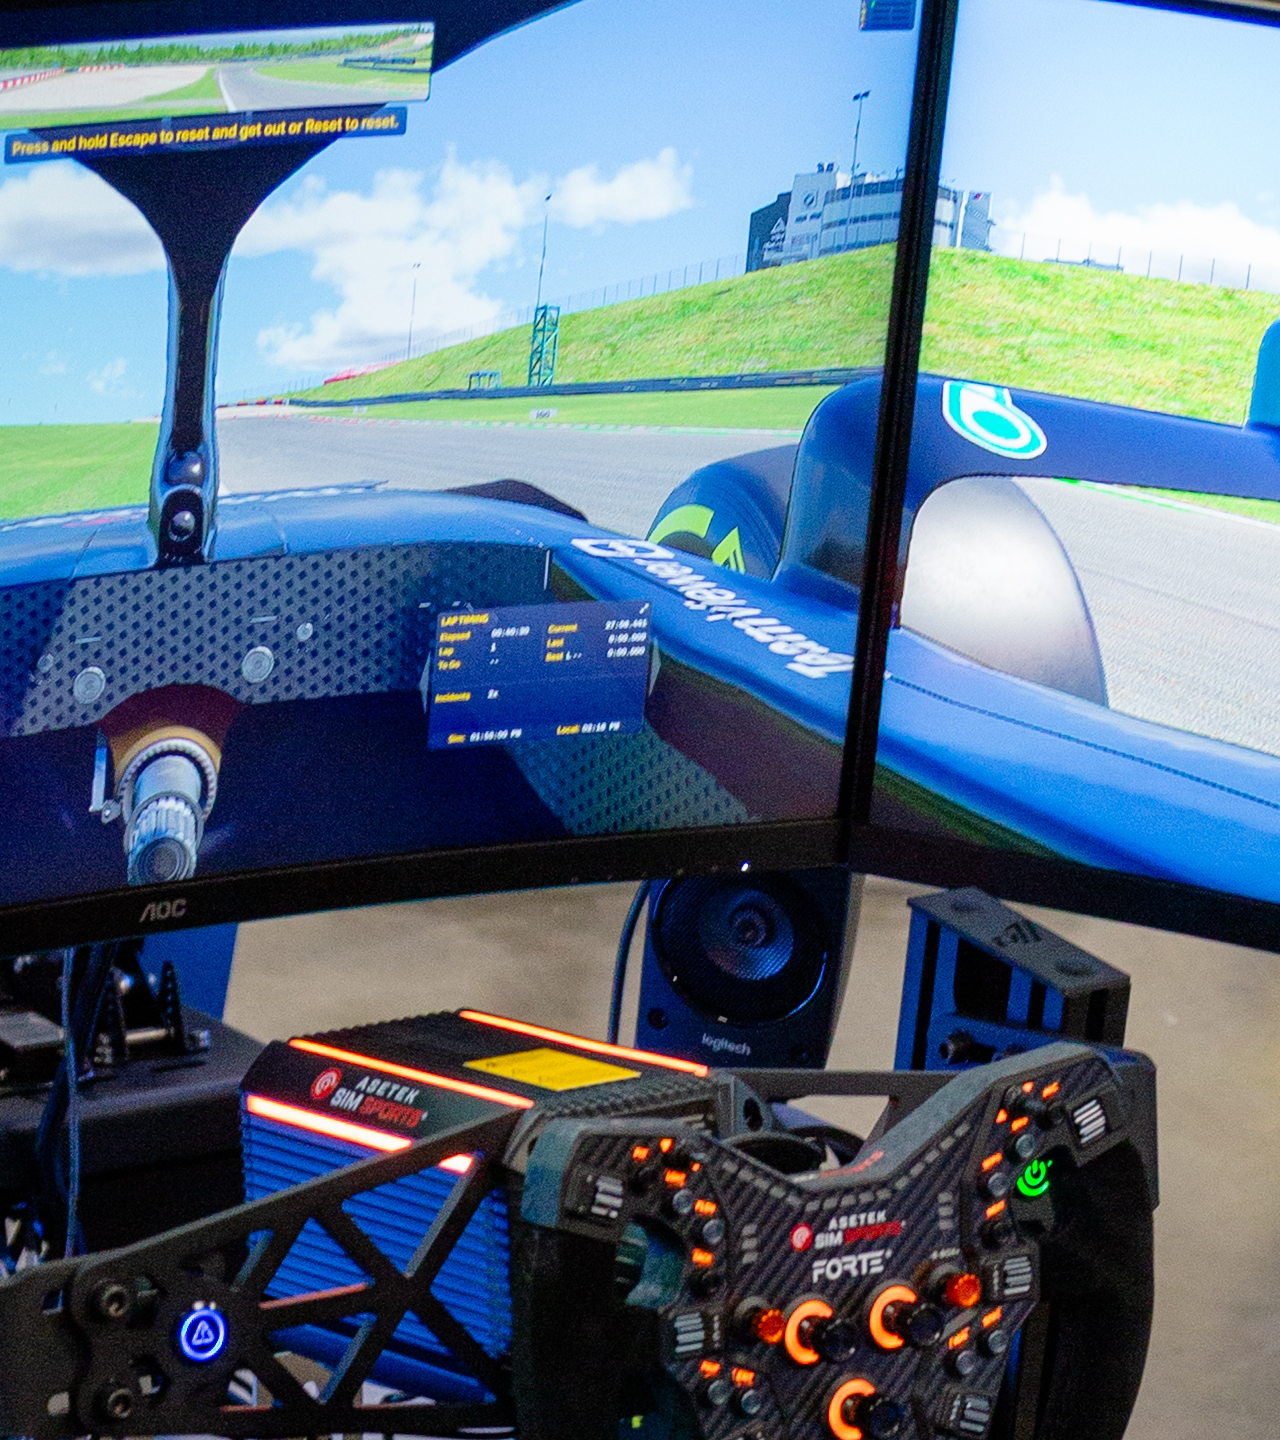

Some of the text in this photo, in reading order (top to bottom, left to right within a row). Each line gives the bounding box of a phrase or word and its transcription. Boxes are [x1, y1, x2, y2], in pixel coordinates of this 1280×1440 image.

[11, 113, 400, 157] Press and hold Escape to reset and get out or Reset to reset.
[138, 897, 187, 924] AOC
[701, 1032, 752, 1056] logitech
[354, 1075, 420, 1105] ASETEK
[828, 1209, 887, 1231] ASETEK
[812, 1249, 885, 1284] FORTE
